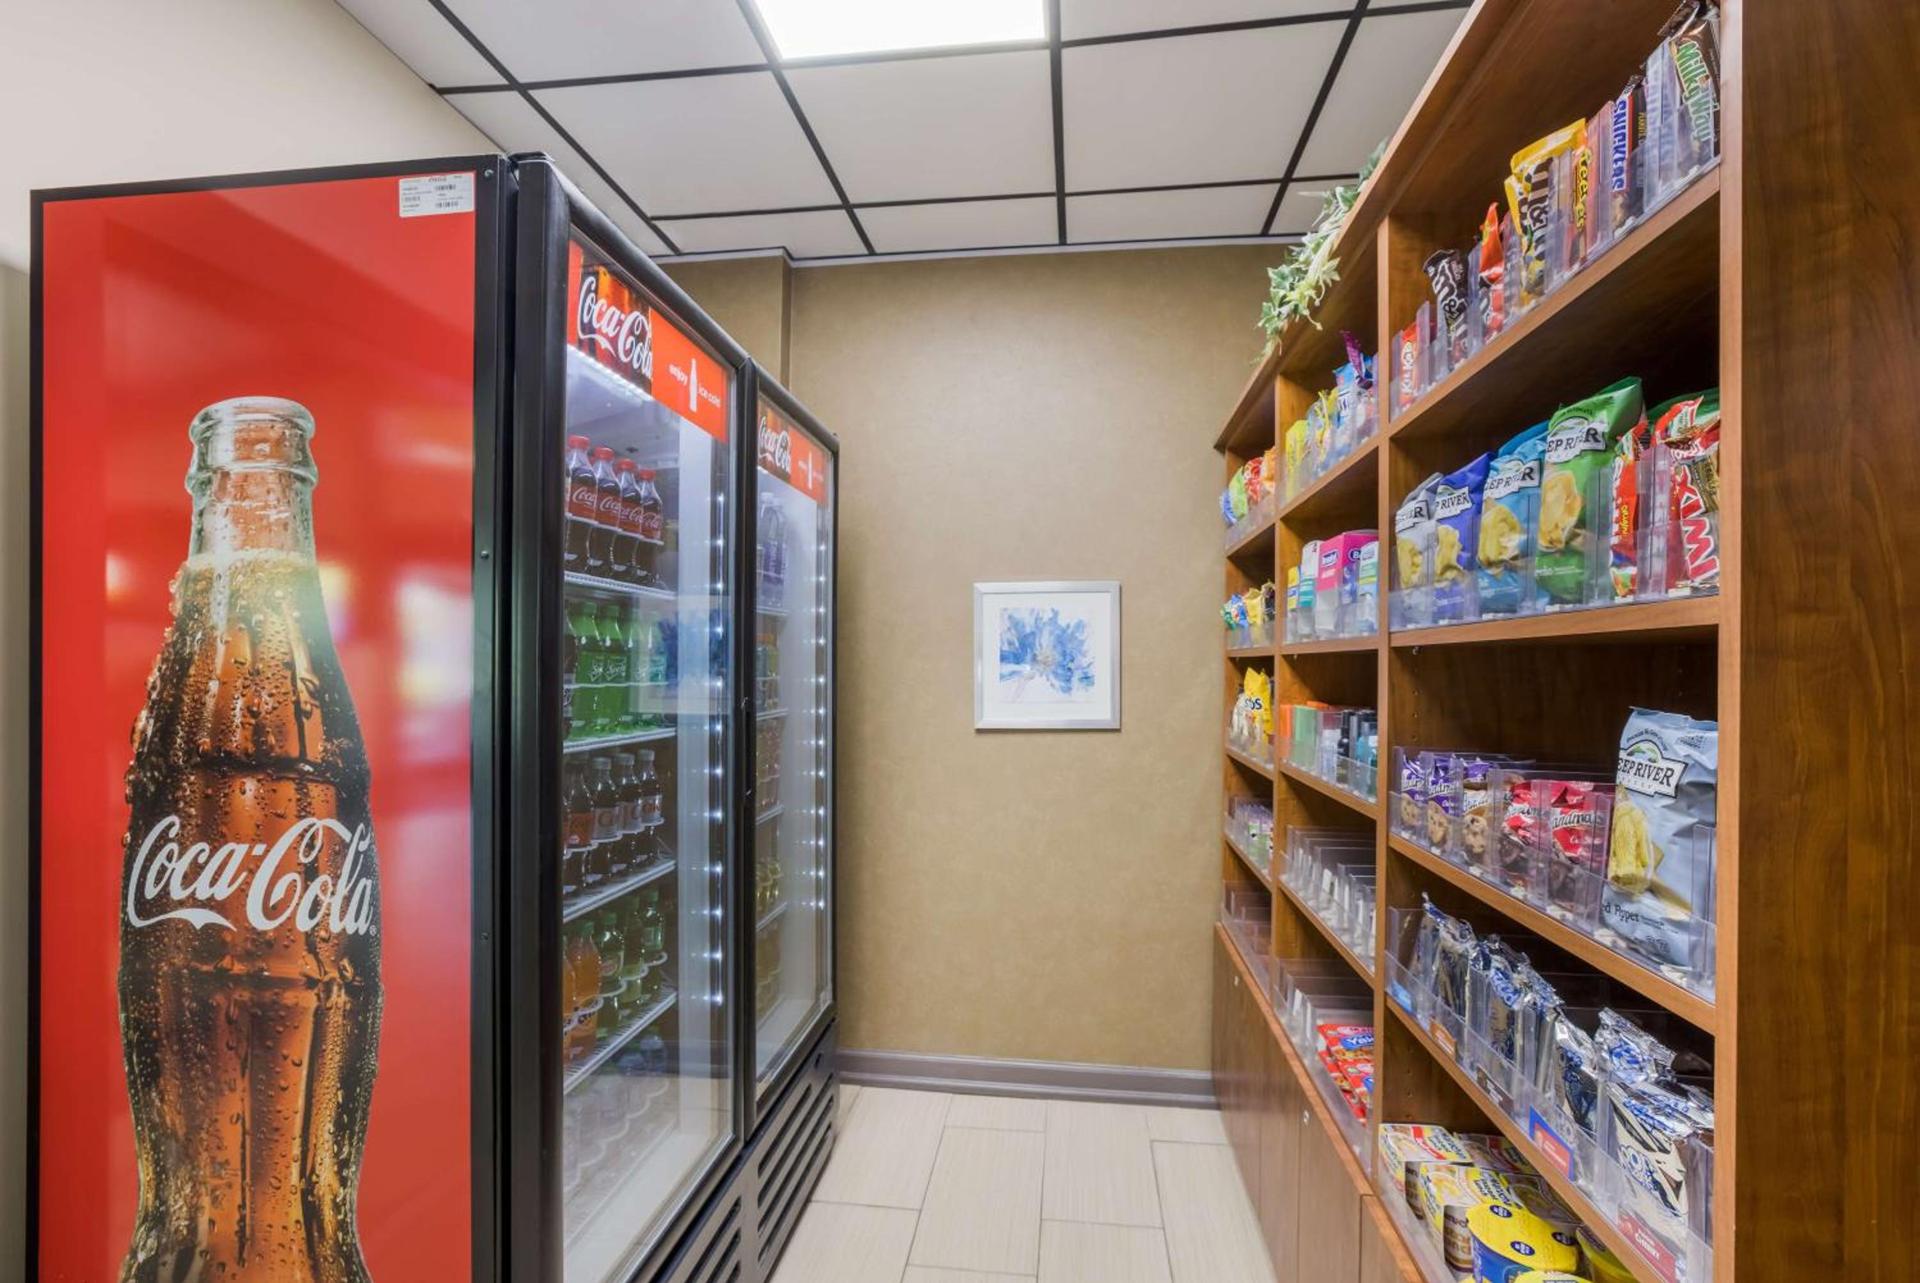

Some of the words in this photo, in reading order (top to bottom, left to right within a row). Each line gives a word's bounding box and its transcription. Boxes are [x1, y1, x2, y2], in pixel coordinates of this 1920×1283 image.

[1611, 99, 1628, 192] SNICKERS
[1440, 491, 1470, 510] RIVER
[1634, 762, 1676, 787] RIVER
[127, 815, 374, 936] Coca-Cola
